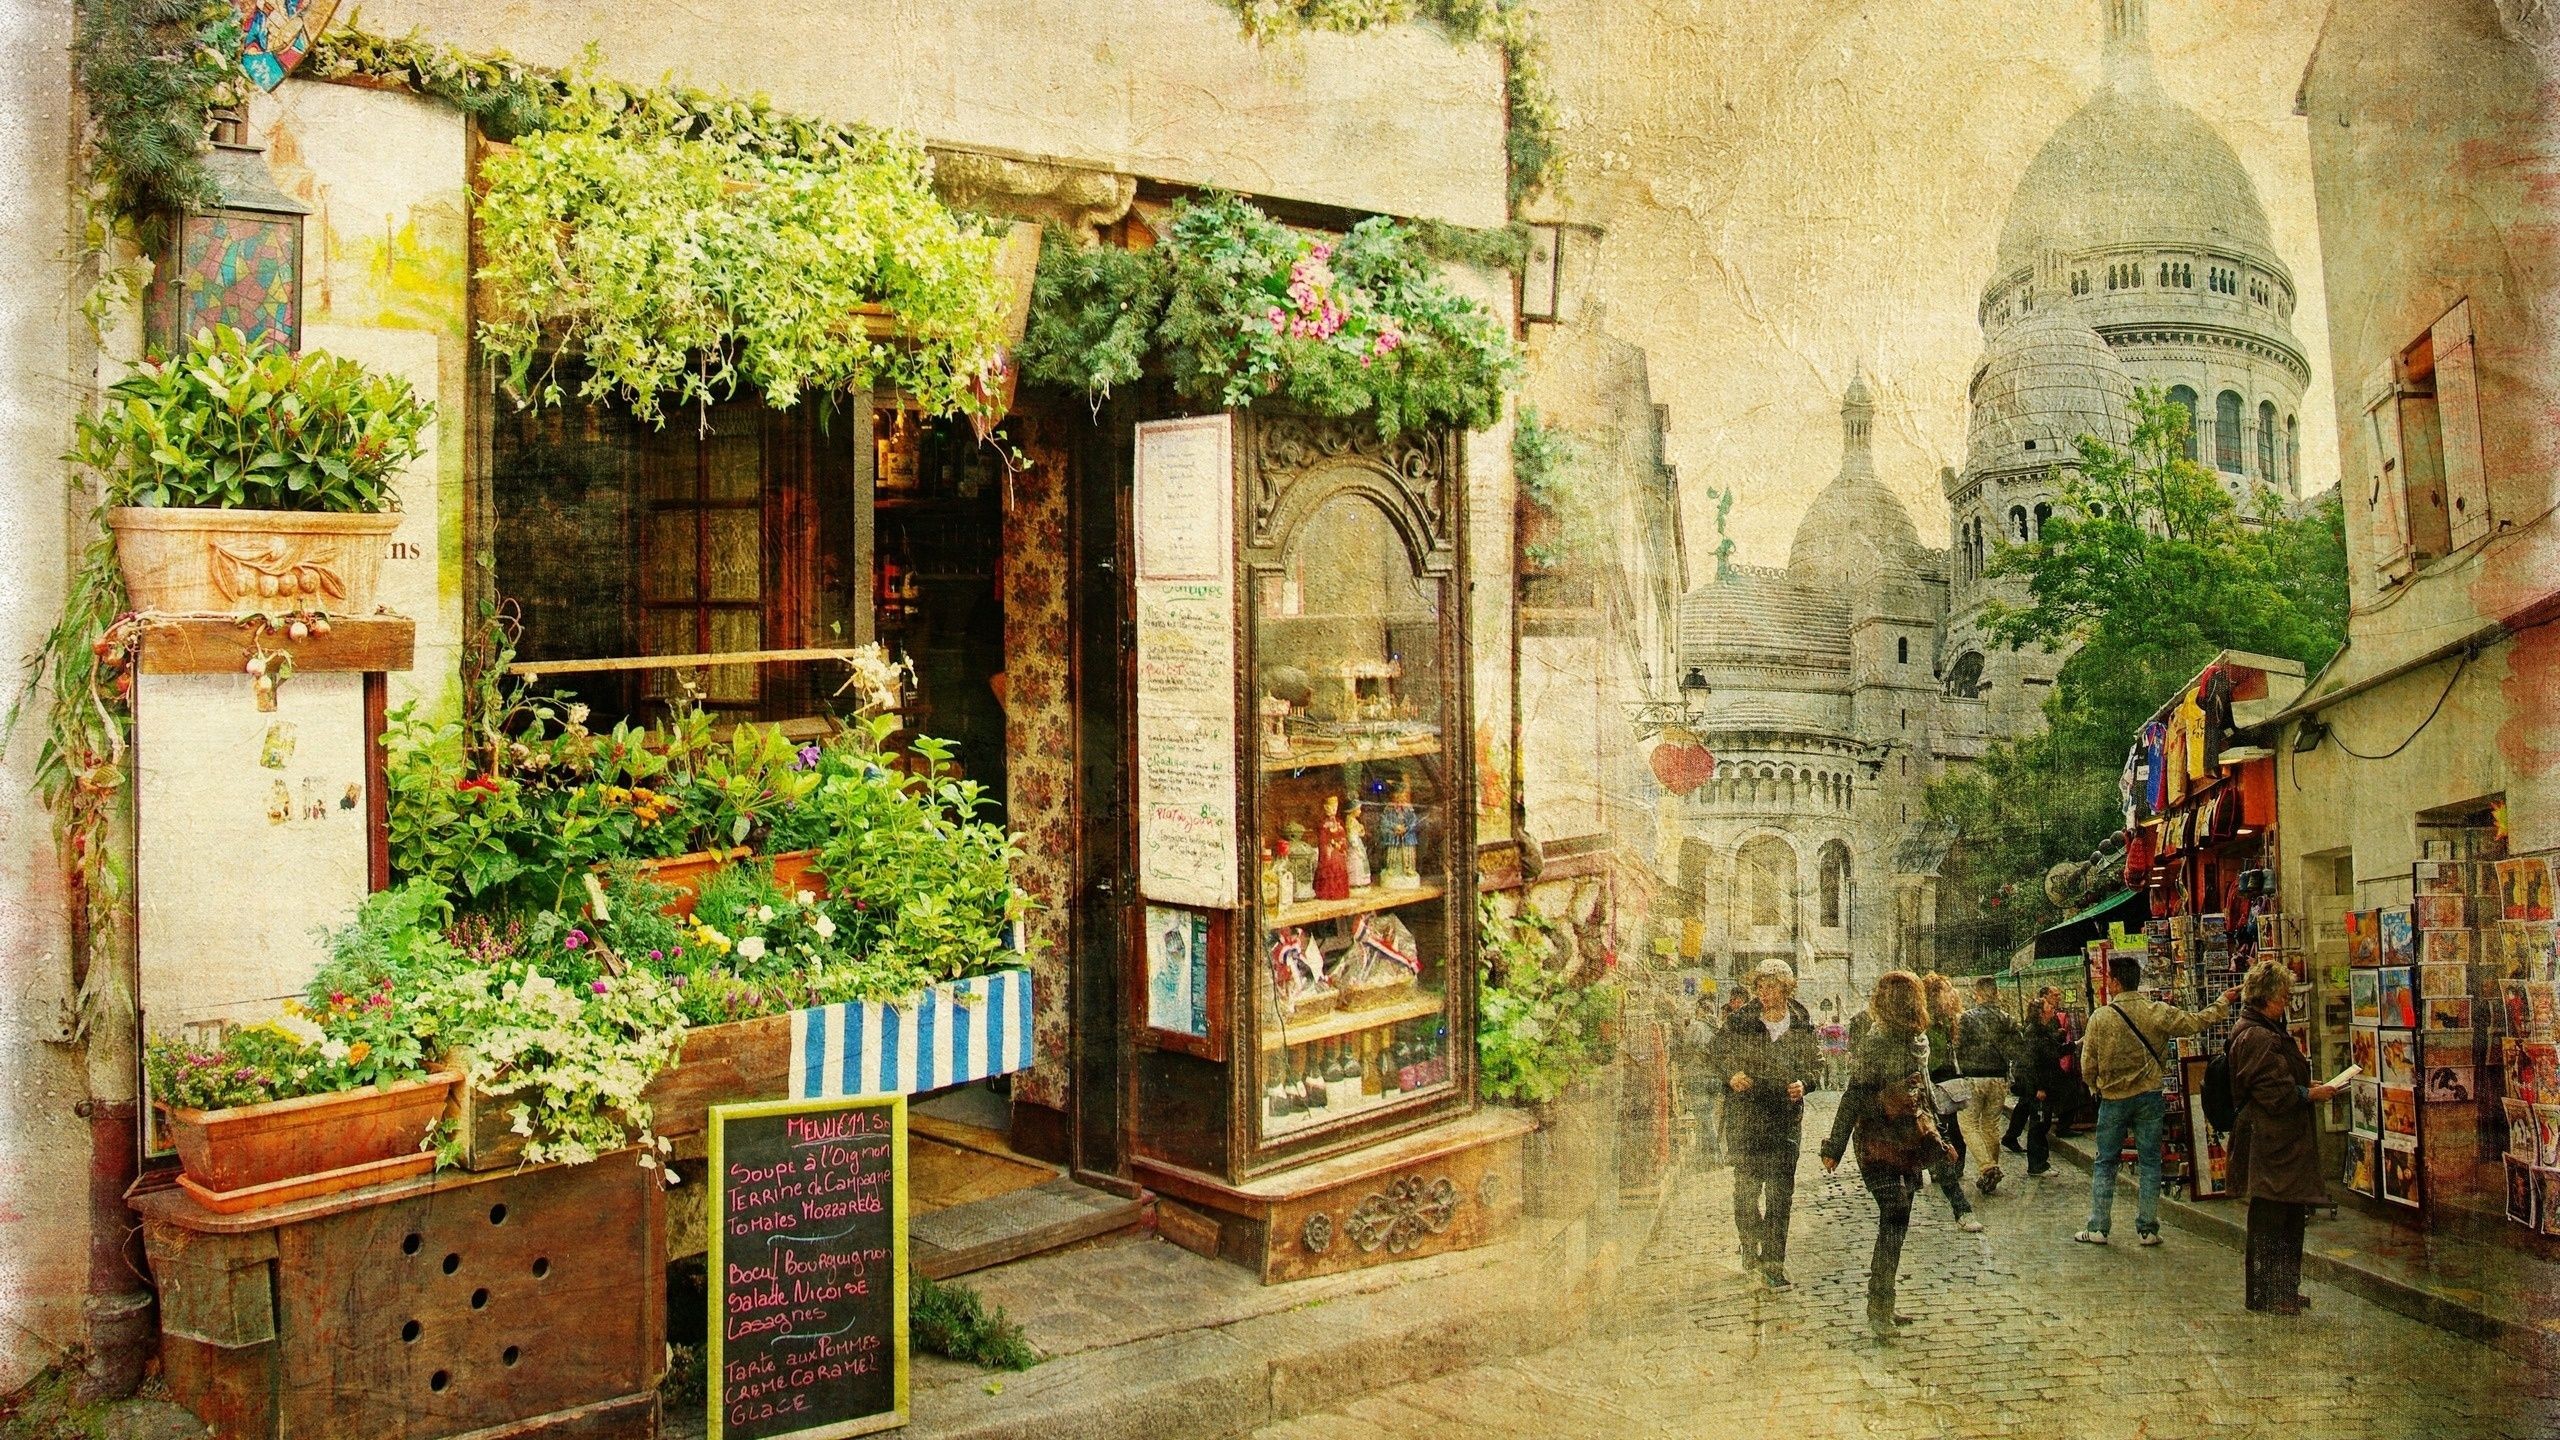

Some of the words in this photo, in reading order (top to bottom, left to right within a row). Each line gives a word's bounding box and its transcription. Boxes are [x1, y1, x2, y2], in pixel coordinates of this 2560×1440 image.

[787, 1117, 836, 1141] MENU
[804, 1153, 817, 1171] à
[821, 1143, 890, 1175] l'Oignon
[808, 1173, 823, 1195] de
[727, 1307, 827, 1341] Lasagnes
[786, 1350, 817, 1366] aux
